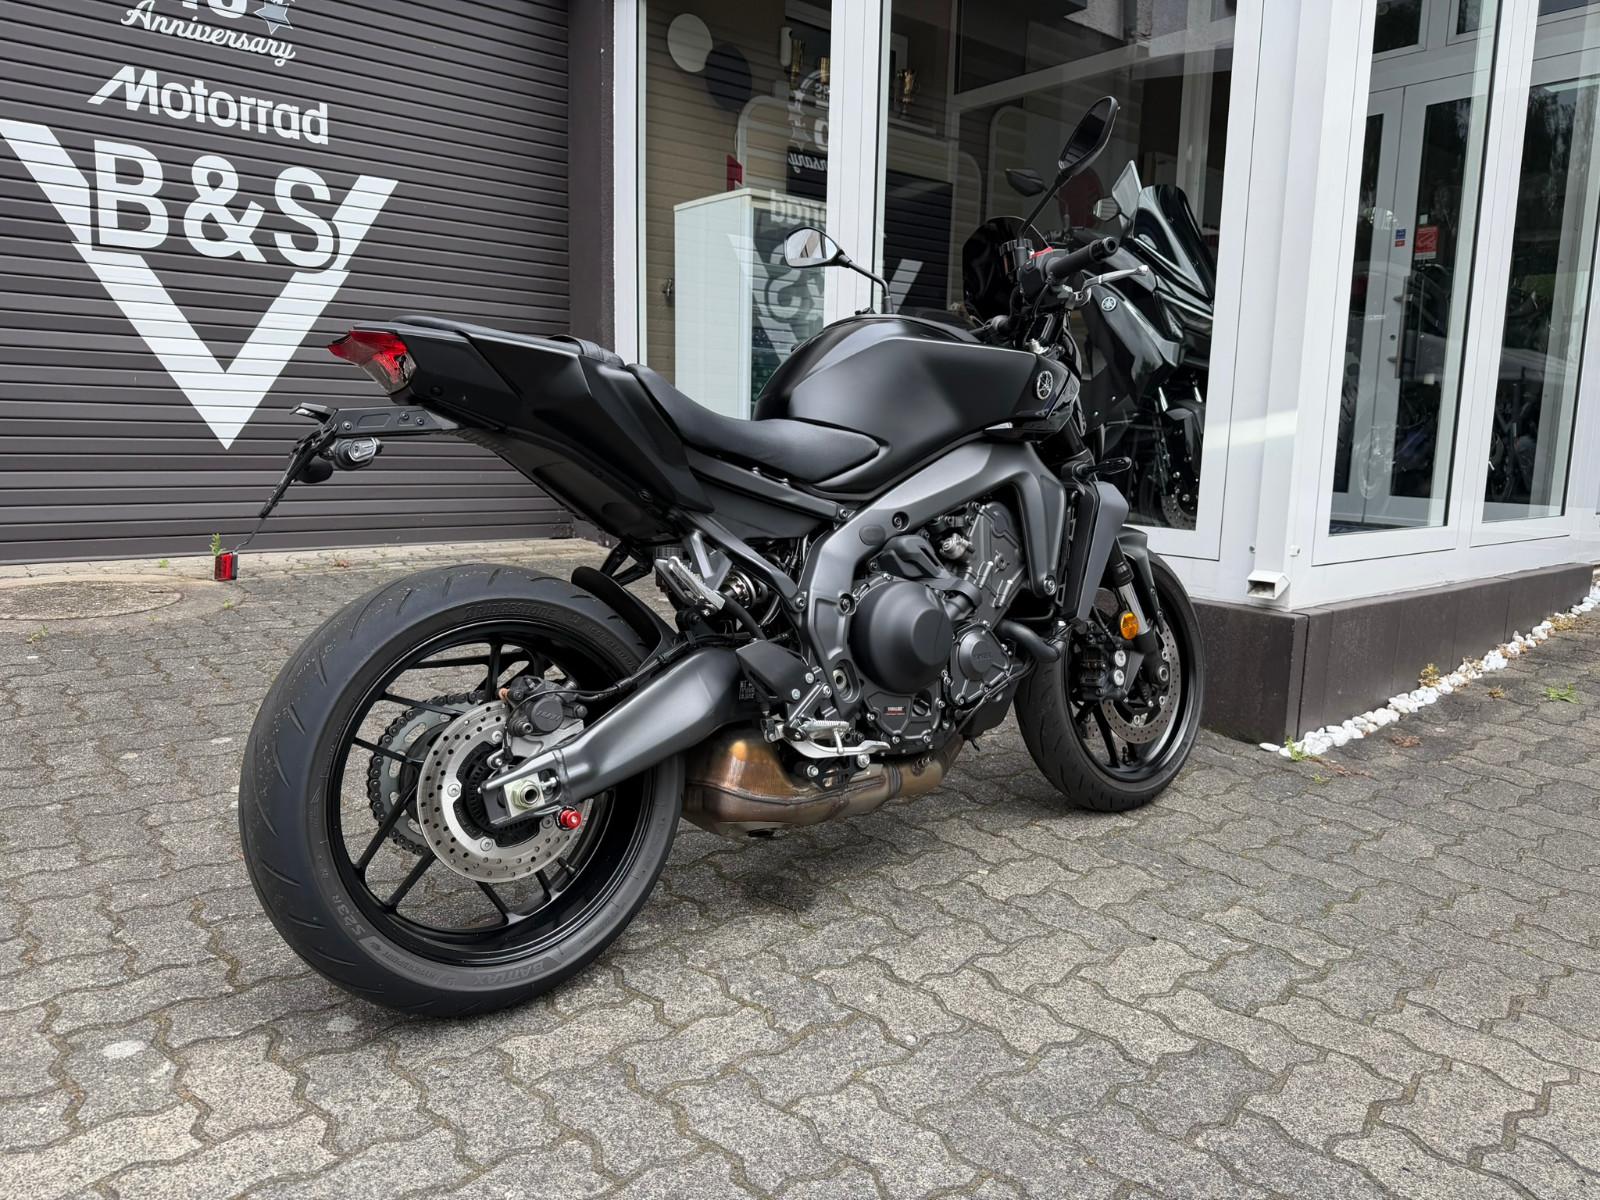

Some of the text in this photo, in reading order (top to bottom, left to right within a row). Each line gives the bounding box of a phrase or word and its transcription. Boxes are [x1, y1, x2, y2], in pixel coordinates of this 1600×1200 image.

[121, 0, 296, 67] Anniversary
[87, 65, 329, 145] Motorrad
[94, 139, 334, 267] B&S
